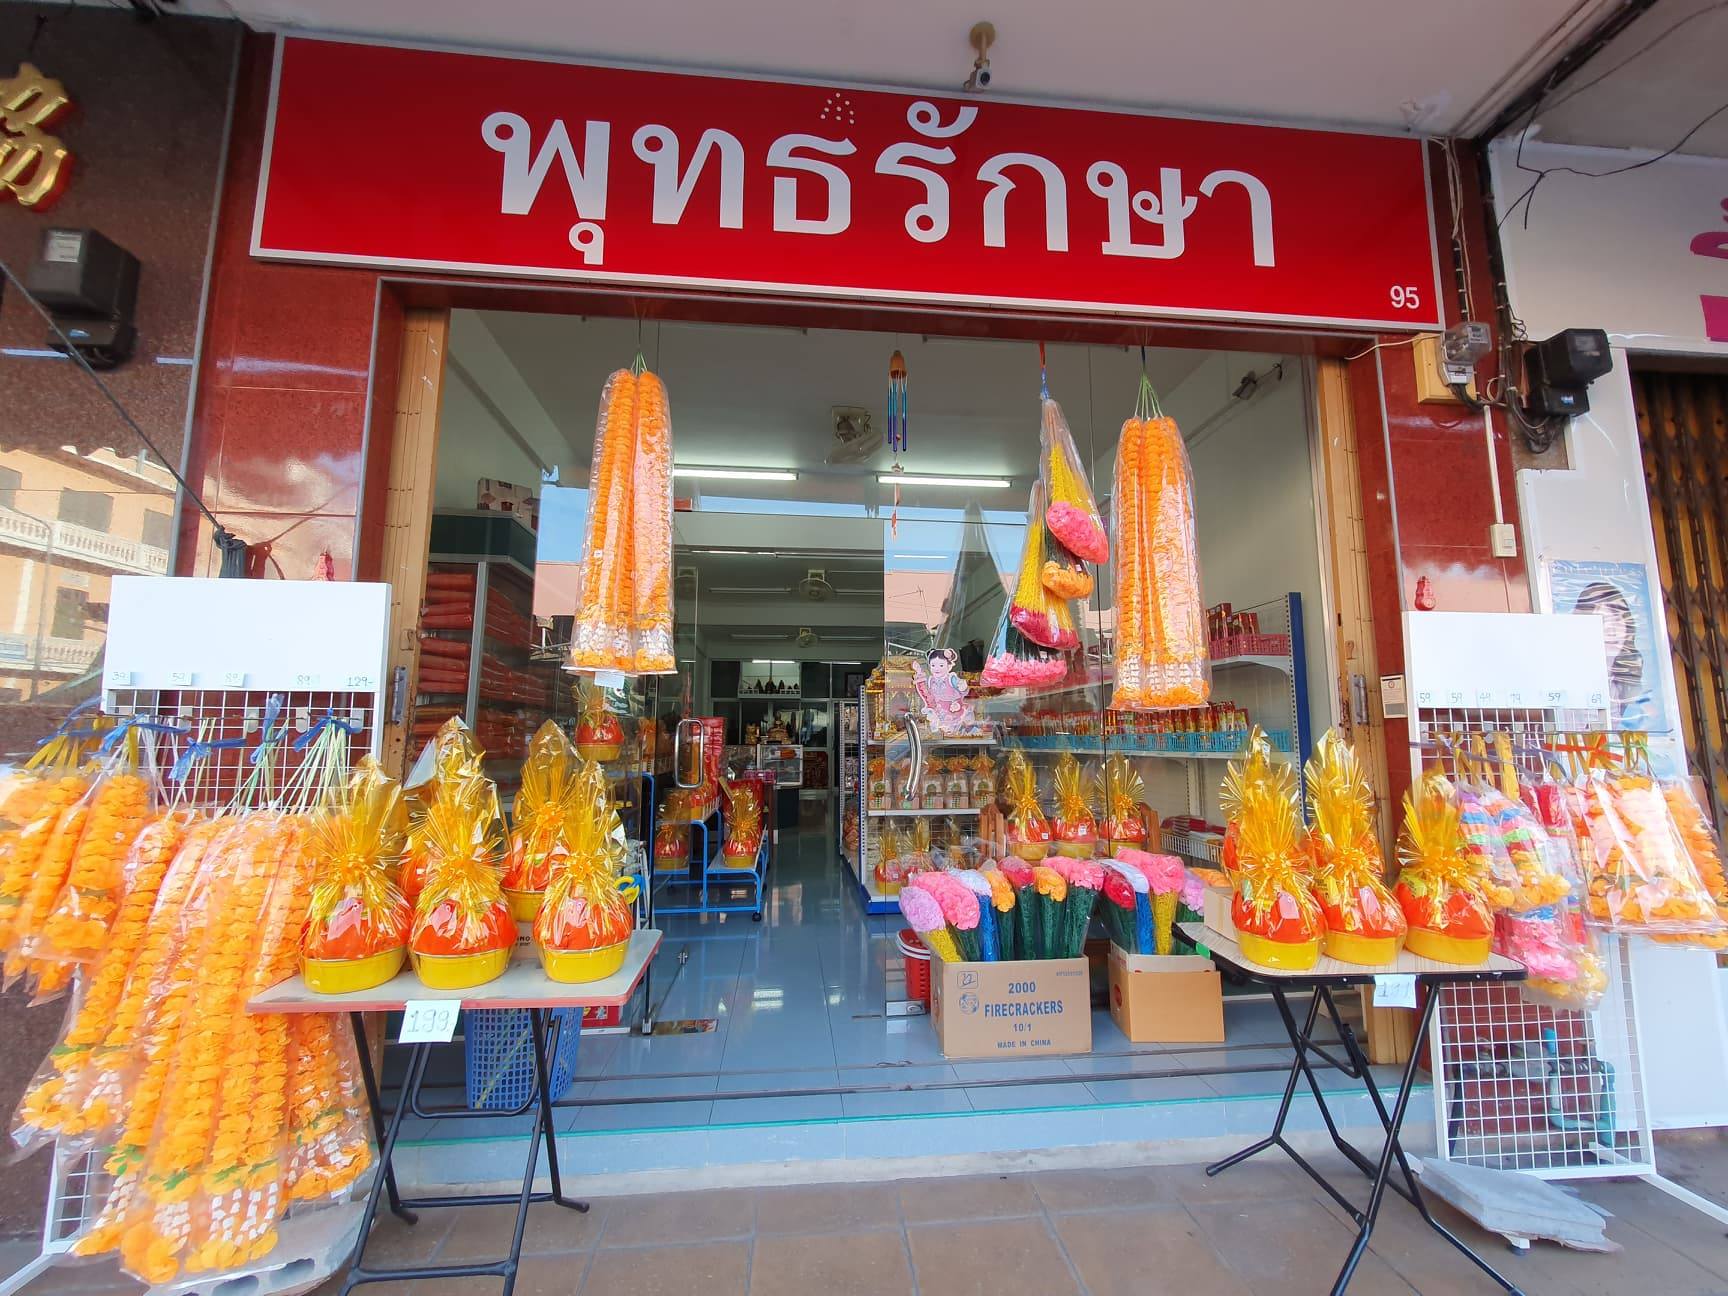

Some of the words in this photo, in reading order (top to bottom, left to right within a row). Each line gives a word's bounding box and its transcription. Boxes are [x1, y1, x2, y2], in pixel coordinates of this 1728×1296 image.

[481, 101, 1276, 268] พุทธรักษา
[1390, 285, 1420, 309] 95
[1008, 981, 1036, 994] 2000
[984, 1000, 1063, 1018] FIRECRACKERS
[1013, 1023, 1032, 1032] 10/1
[997, 1041, 1016, 1049] MADE
[1030, 1039, 1052, 1047] CHINA
